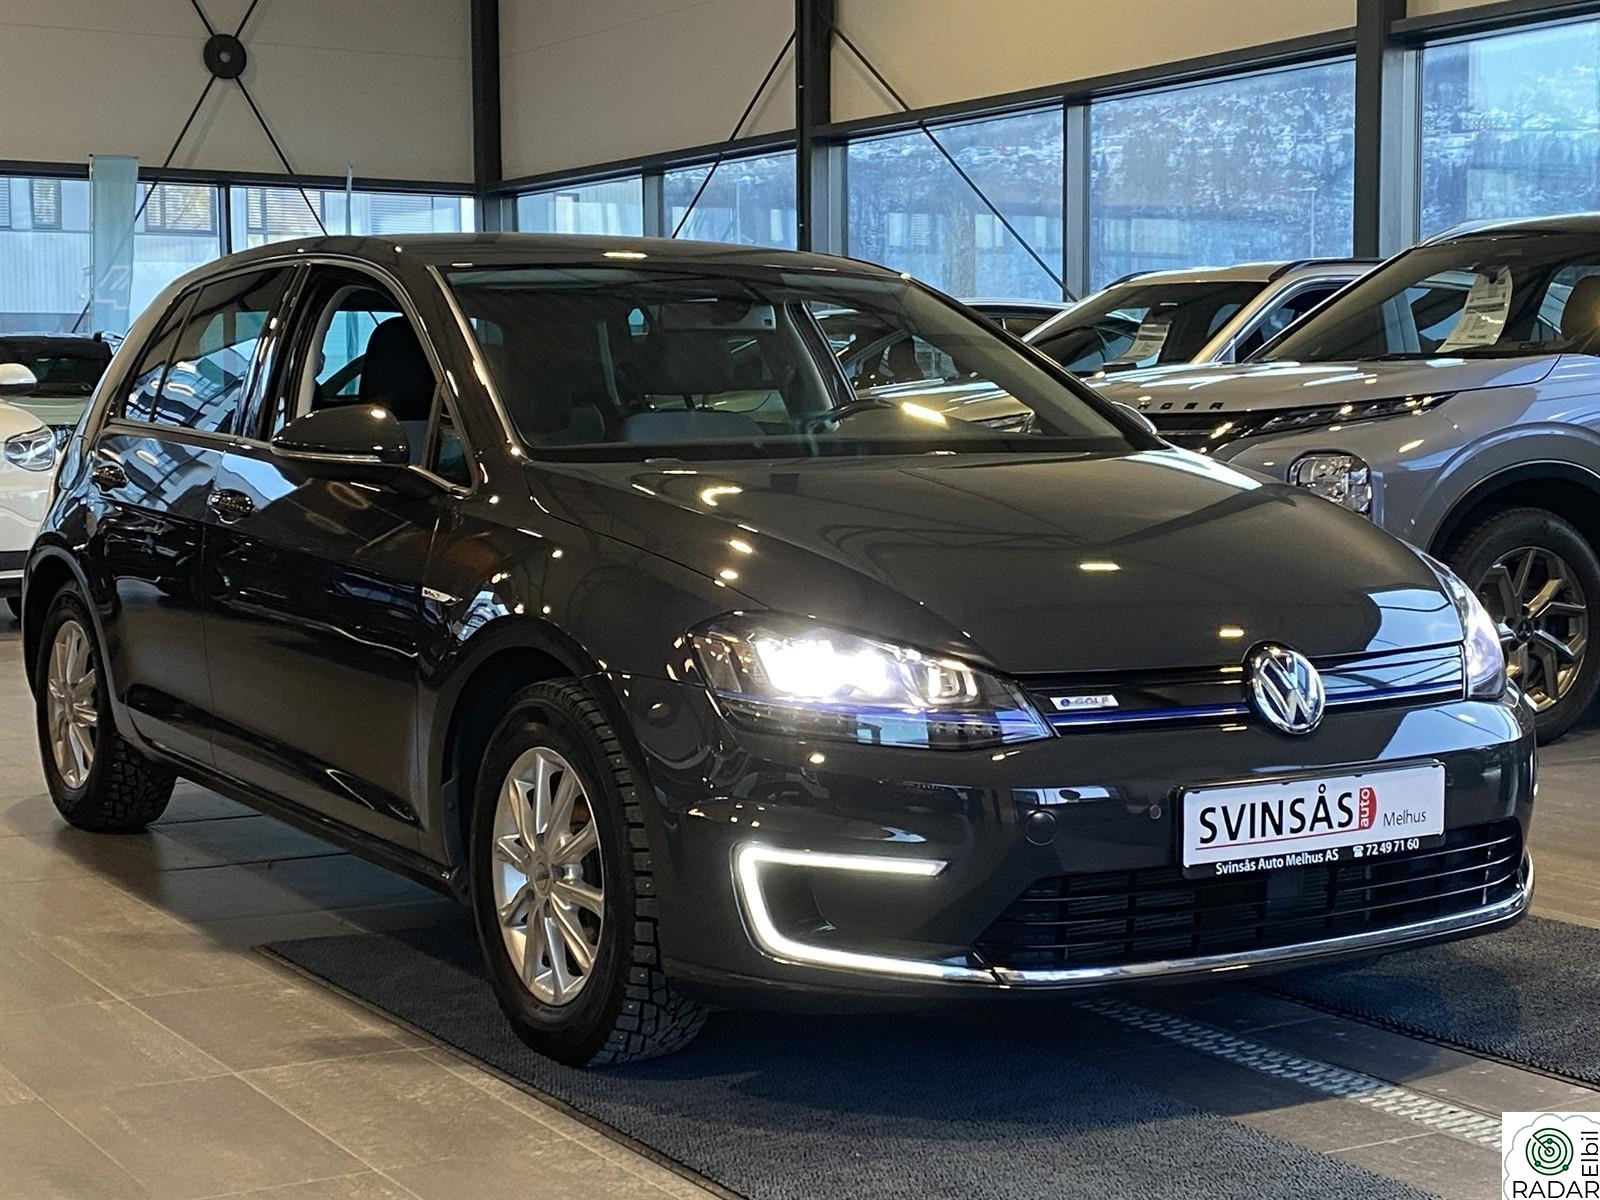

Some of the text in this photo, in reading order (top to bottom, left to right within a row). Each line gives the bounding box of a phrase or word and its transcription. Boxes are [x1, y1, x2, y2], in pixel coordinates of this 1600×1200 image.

[1199, 783, 1354, 844] SVINSÅS
[1360, 788, 1371, 828] auto
[1383, 809, 1427, 827] Melhus
[1366, 837, 1420, 856] 72 49 71 60
[1215, 848, 1339, 875] Svinsås Auto Melhus AS
